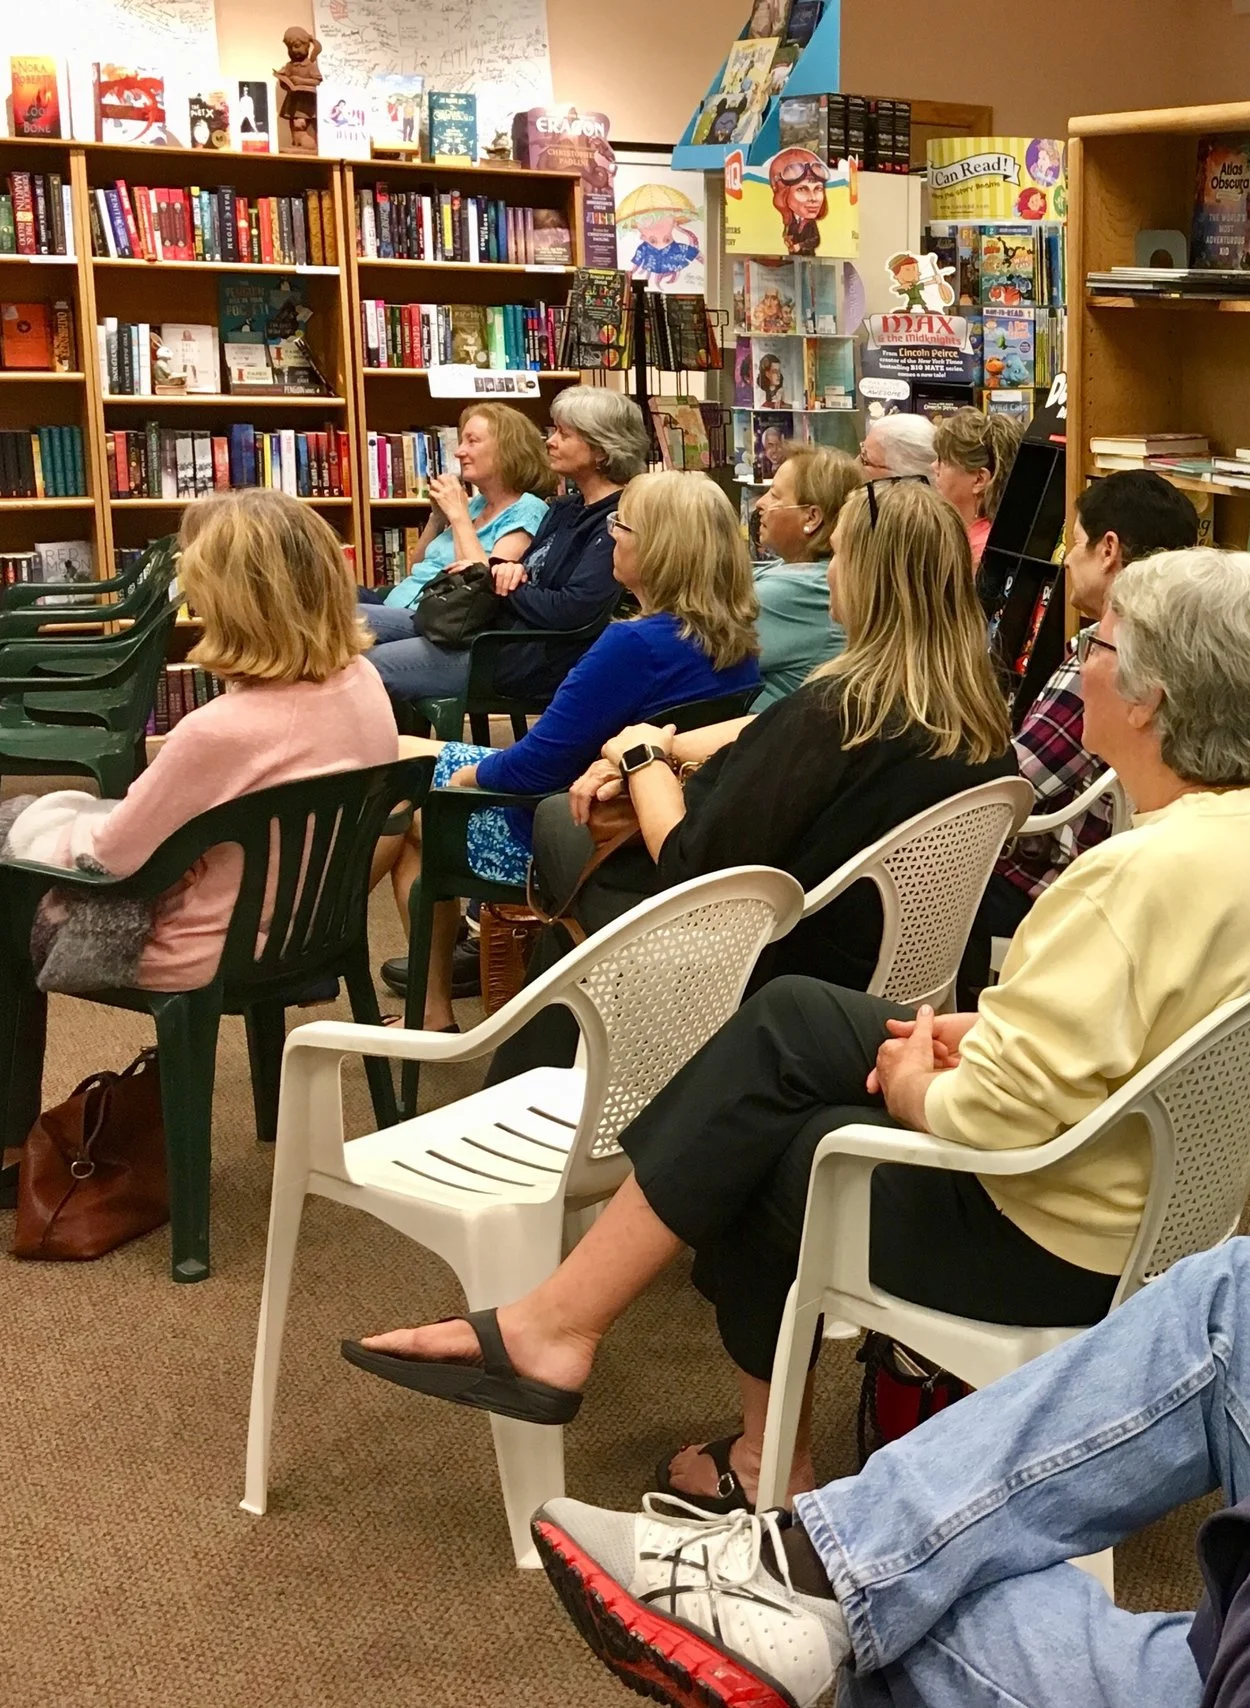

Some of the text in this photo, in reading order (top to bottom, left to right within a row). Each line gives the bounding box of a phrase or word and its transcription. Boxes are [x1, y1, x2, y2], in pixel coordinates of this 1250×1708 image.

[23, 122, 51, 134] BONE
[536, 116, 605, 138] ERAGON
[935, 170, 959, 186] Can
[960, 158, 1009, 178] Read!
[1220, 162, 1243, 176] Atlas
[13, 174, 25, 211] MARTIN
[1210, 177, 1250, 194] Obscura
[225, 222, 233, 250] STORM
[881, 314, 956, 335] MAX
[412, 325, 420, 360] GENESIS
[886, 333, 962, 346] the Midknights
[899, 347, 930, 358] Lincoln
[879, 363, 910, 372] bestselling
[989, 401, 1009, 413] Wild
[44, 548, 79, 560] RED
[374, 544, 384, 573] DRY
